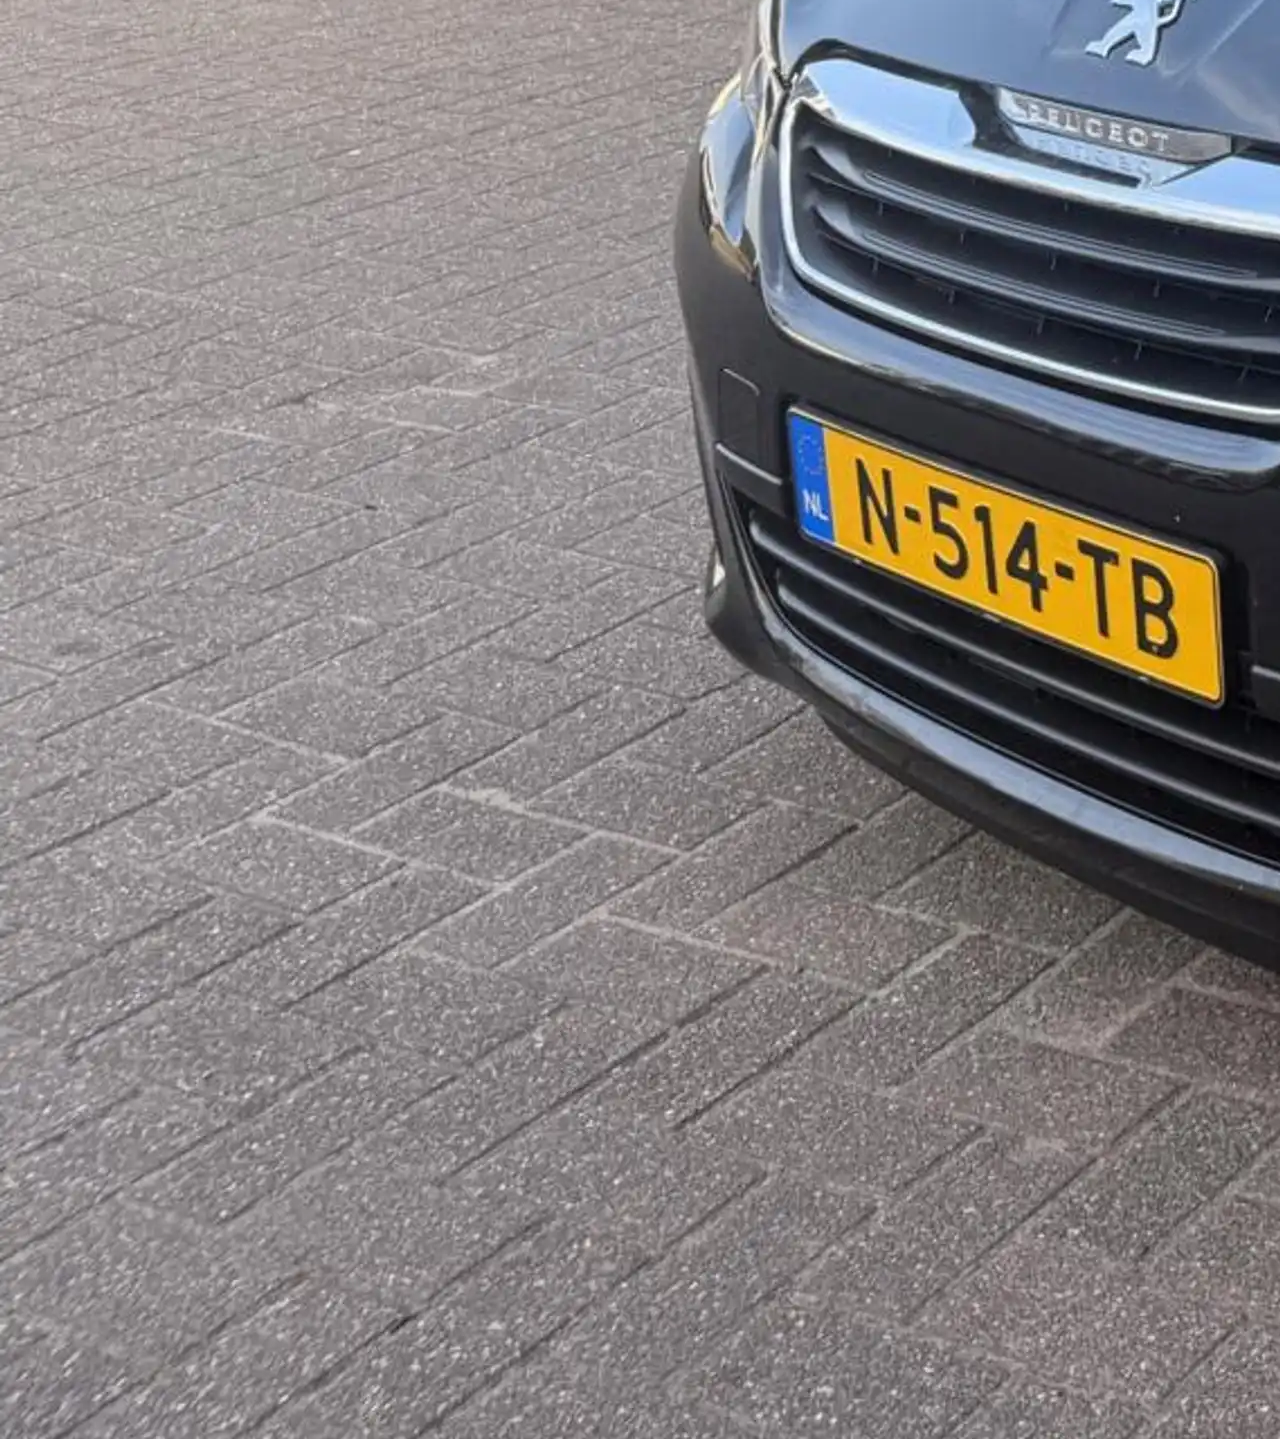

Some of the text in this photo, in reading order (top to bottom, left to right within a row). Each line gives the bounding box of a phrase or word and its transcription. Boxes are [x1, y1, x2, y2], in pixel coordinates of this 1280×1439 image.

[1025, 103, 1169, 153] PEUGEOT
[802, 488, 830, 521] NL
[855, 456, 1179, 659] N-514-TB
